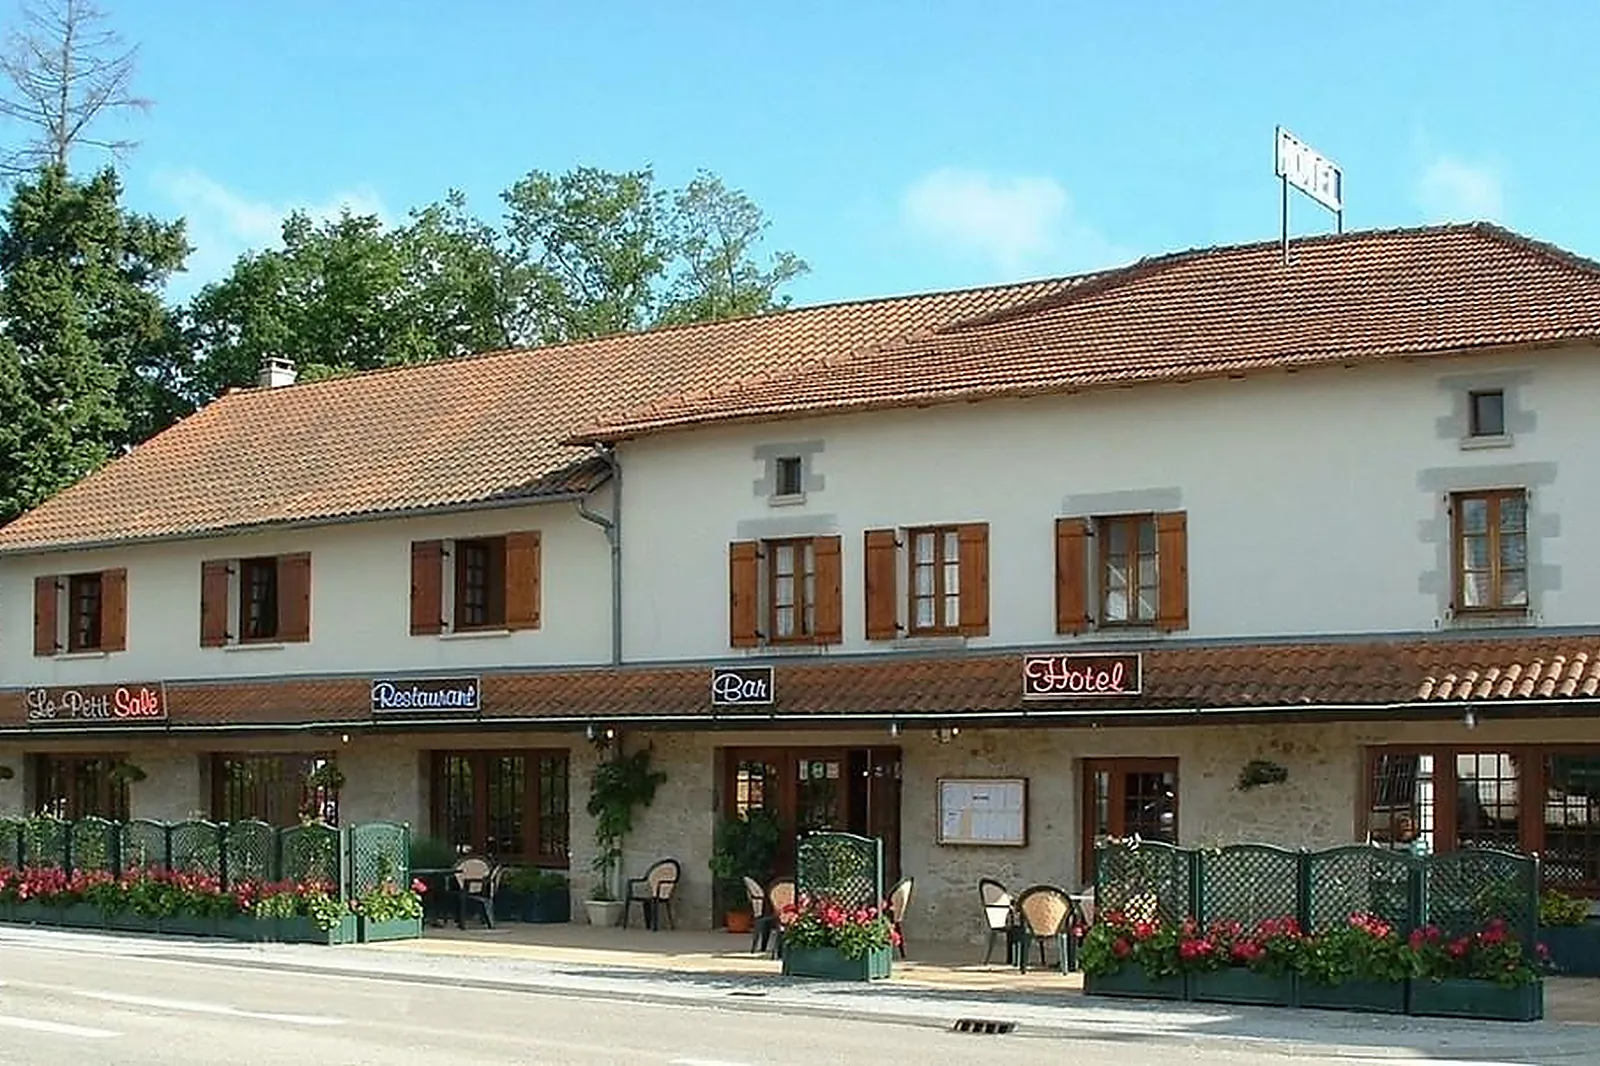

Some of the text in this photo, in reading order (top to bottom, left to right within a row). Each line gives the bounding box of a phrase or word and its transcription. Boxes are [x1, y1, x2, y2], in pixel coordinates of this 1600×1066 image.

[713, 673, 766, 701] Bar
[1025, 658, 1124, 692] Hotel
[27, 687, 158, 718] Le Petit Salé
[371, 682, 475, 708] Restaurant
